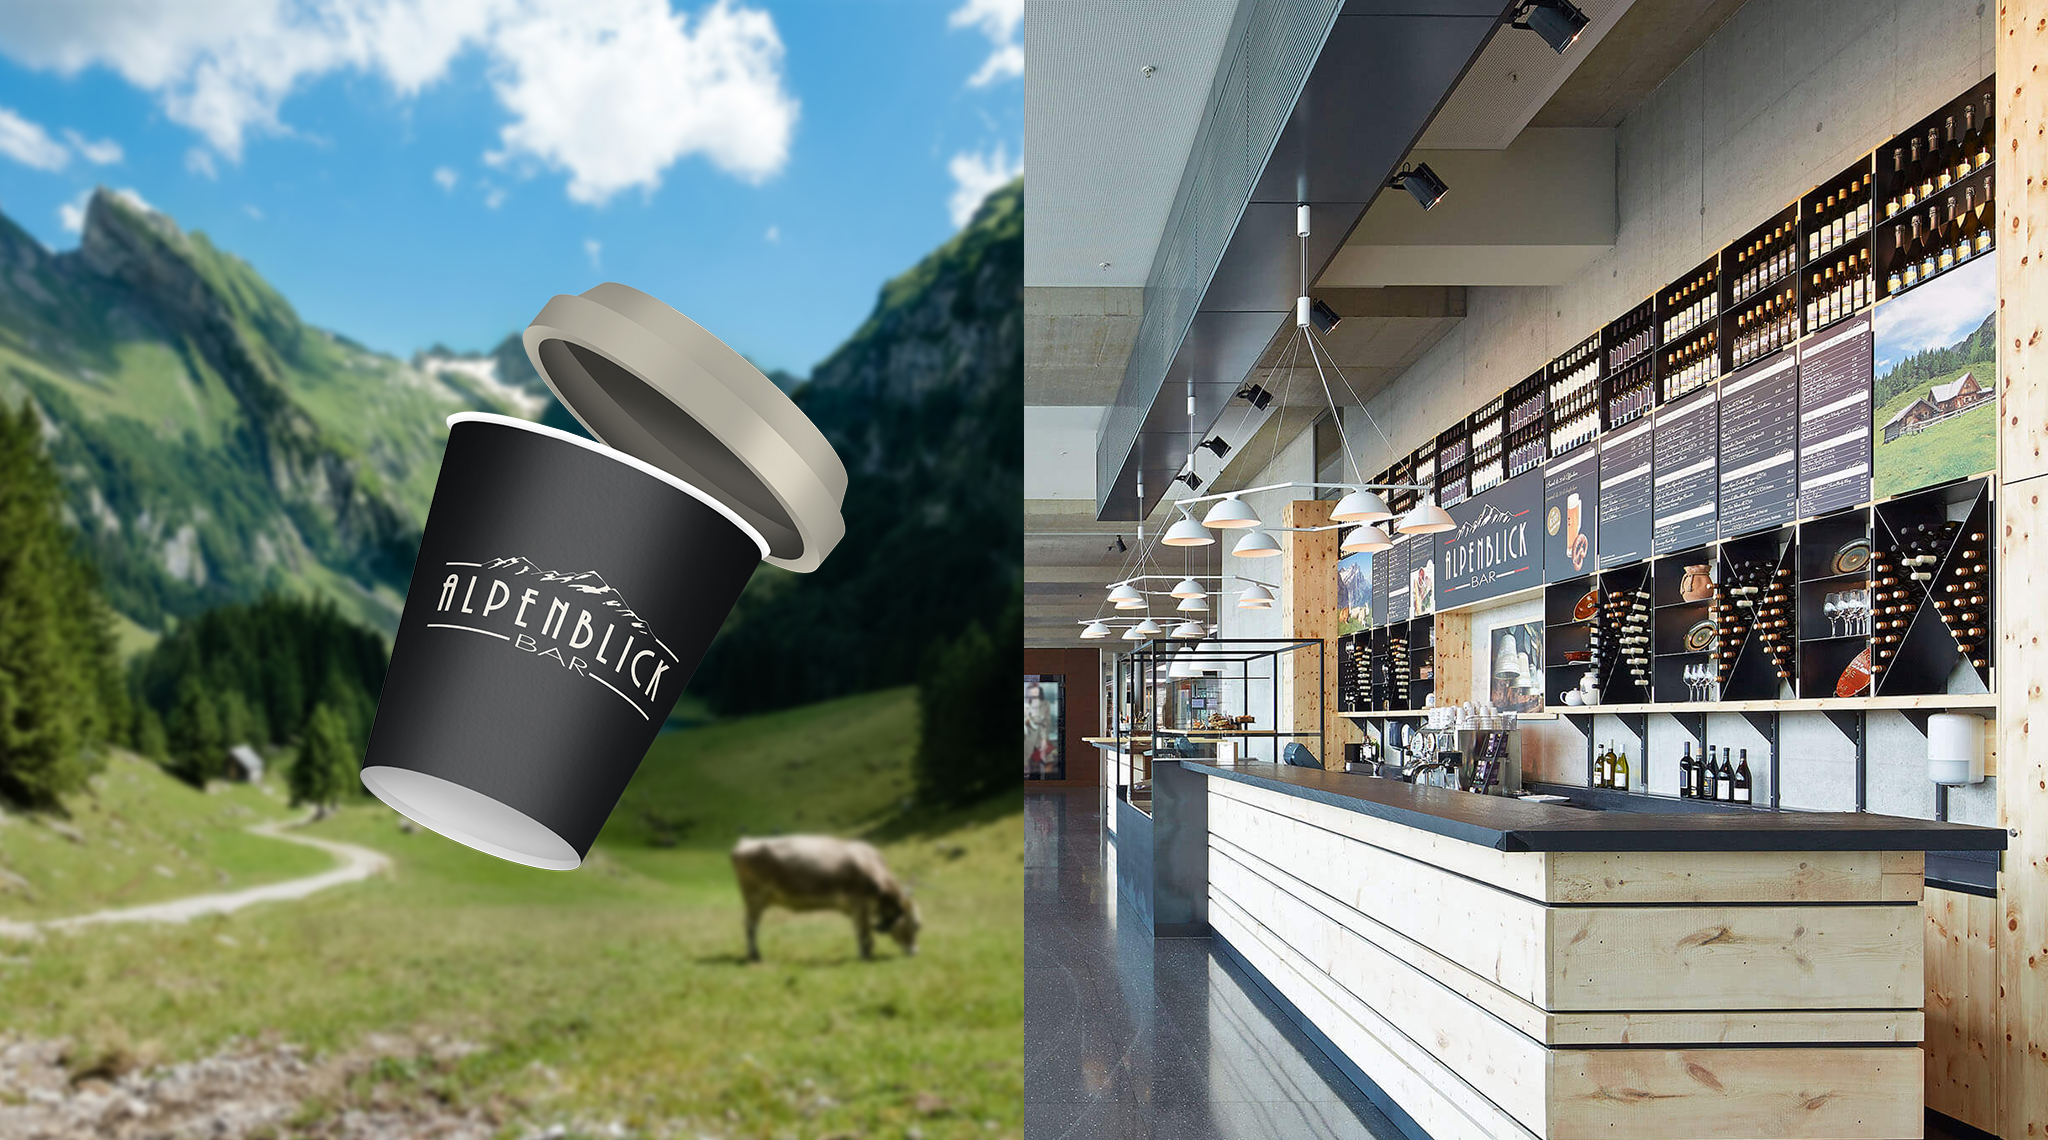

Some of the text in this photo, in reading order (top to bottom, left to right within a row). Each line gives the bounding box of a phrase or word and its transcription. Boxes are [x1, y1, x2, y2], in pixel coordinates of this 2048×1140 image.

[1444, 522, 1528, 580] ALPENBLICK
[1471, 570, 1496, 588] BAR
[437, 573, 670, 702] ALPENBLICK
[514, 633, 589, 677] BAR
